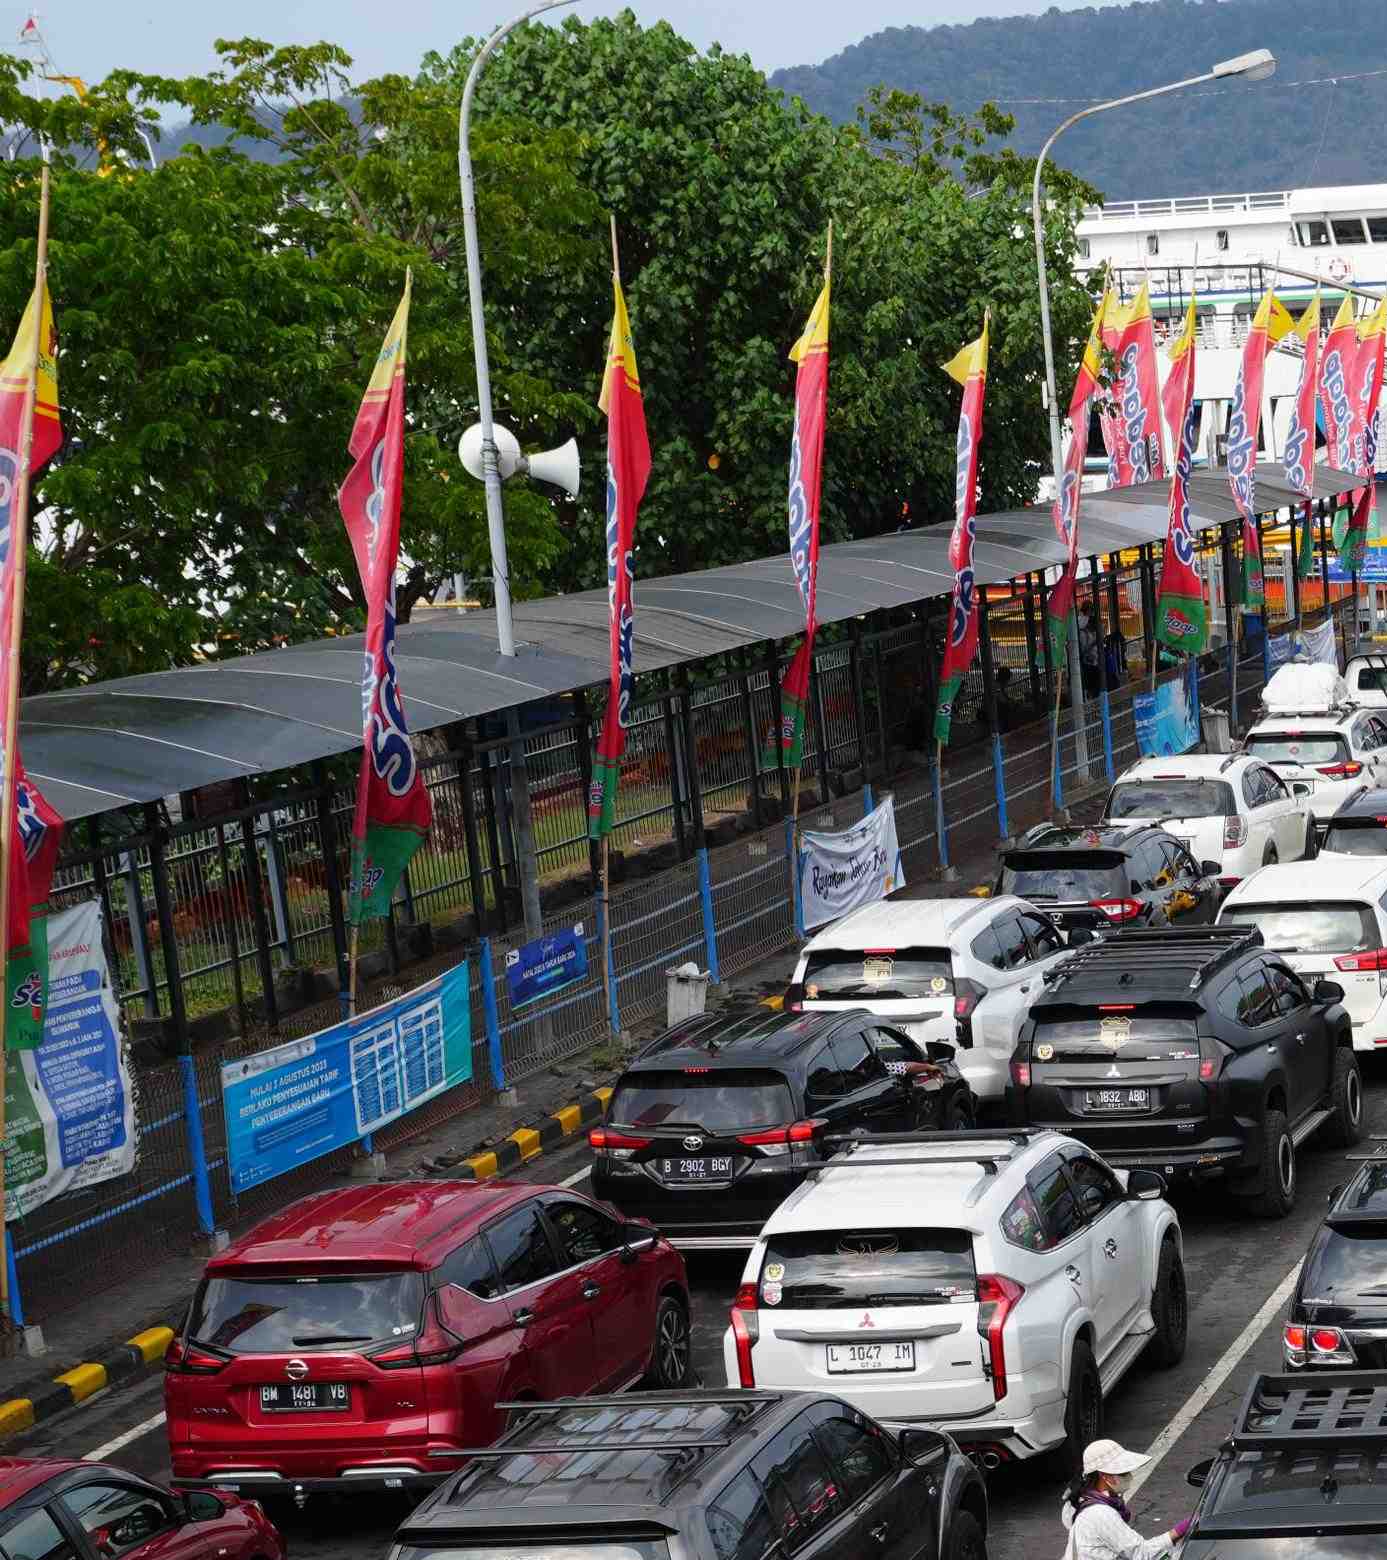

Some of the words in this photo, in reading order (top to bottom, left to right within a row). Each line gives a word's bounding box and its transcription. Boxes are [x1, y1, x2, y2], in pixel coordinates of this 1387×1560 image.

[665, 1163, 671, 1174] B
[679, 1161, 705, 1174] 2902
[712, 1159, 730, 1172] BGY
[831, 1348, 839, 1362] L
[850, 1345, 882, 1361] 1047
[894, 1345, 911, 1359] IM
[262, 1386, 278, 1402] BM
[291, 1384, 316, 1400] 1481
[330, 1384, 346, 1399] VB
